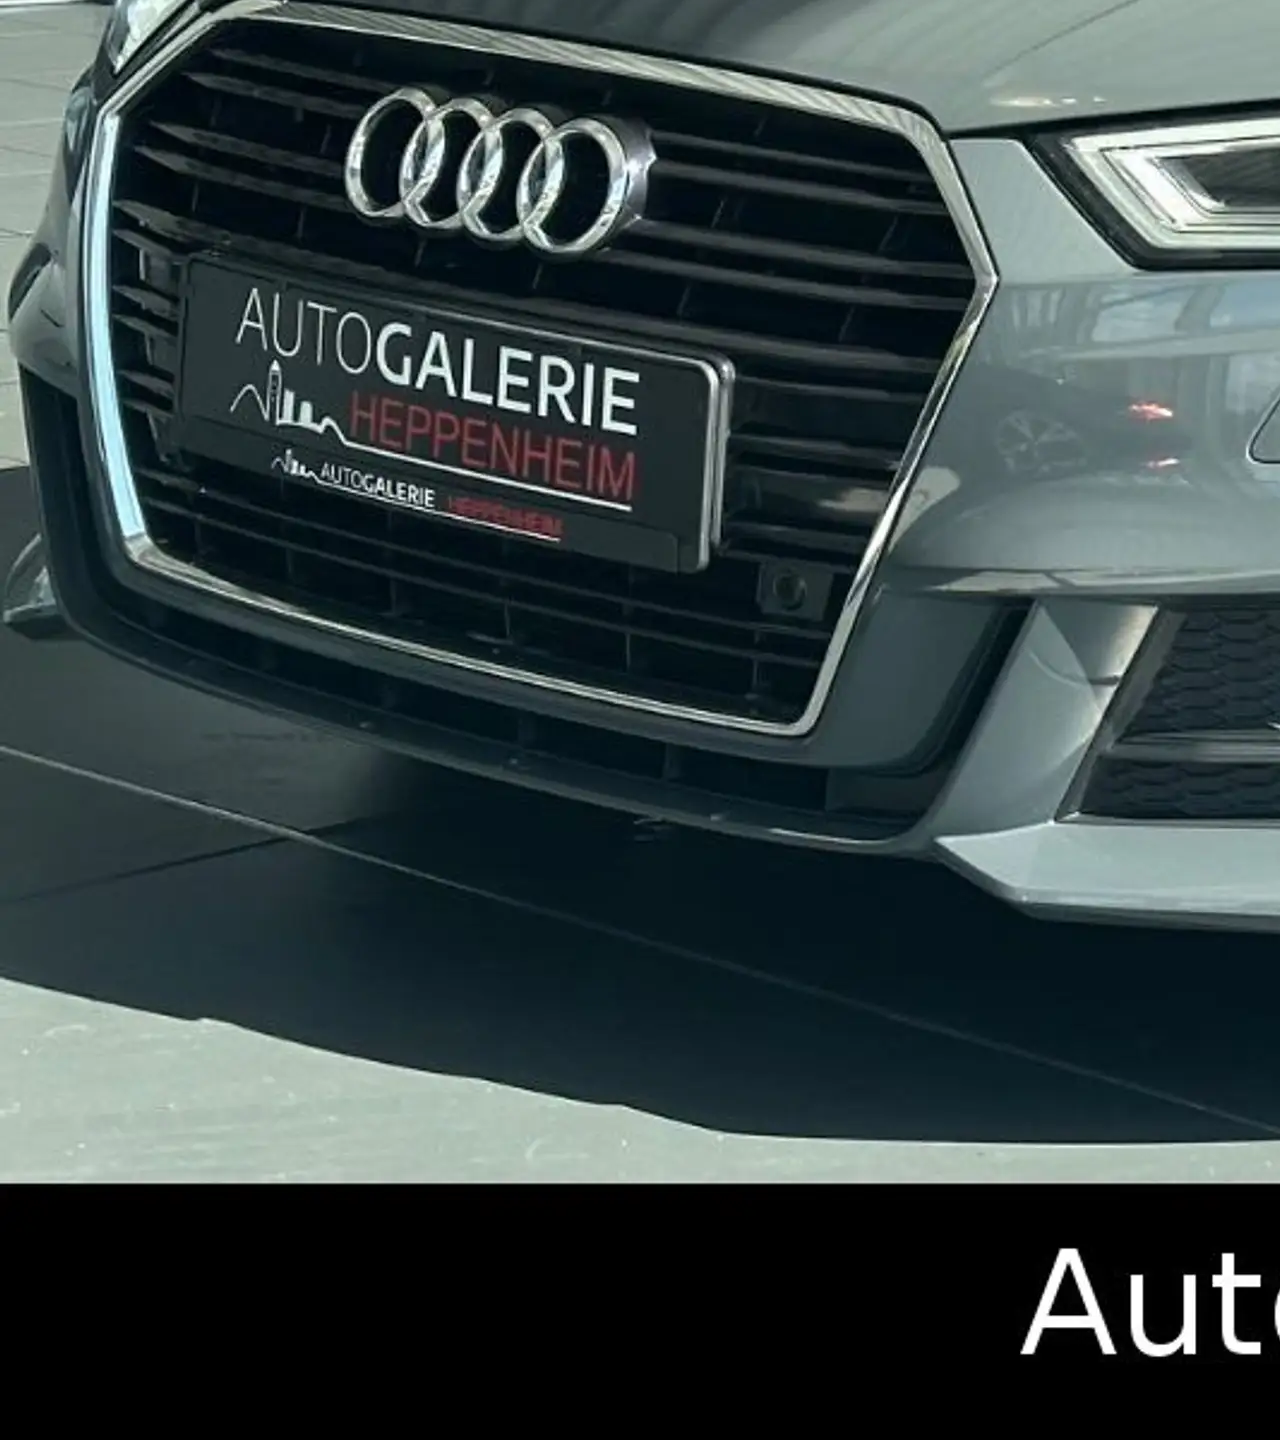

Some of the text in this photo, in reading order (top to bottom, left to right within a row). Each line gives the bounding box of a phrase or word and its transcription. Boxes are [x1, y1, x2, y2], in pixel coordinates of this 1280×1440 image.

[235, 287, 640, 435] AUTOGALERIE
[320, 462, 436, 508] AUTOGALERIE
[349, 390, 637, 501] HEPPENHEIM
